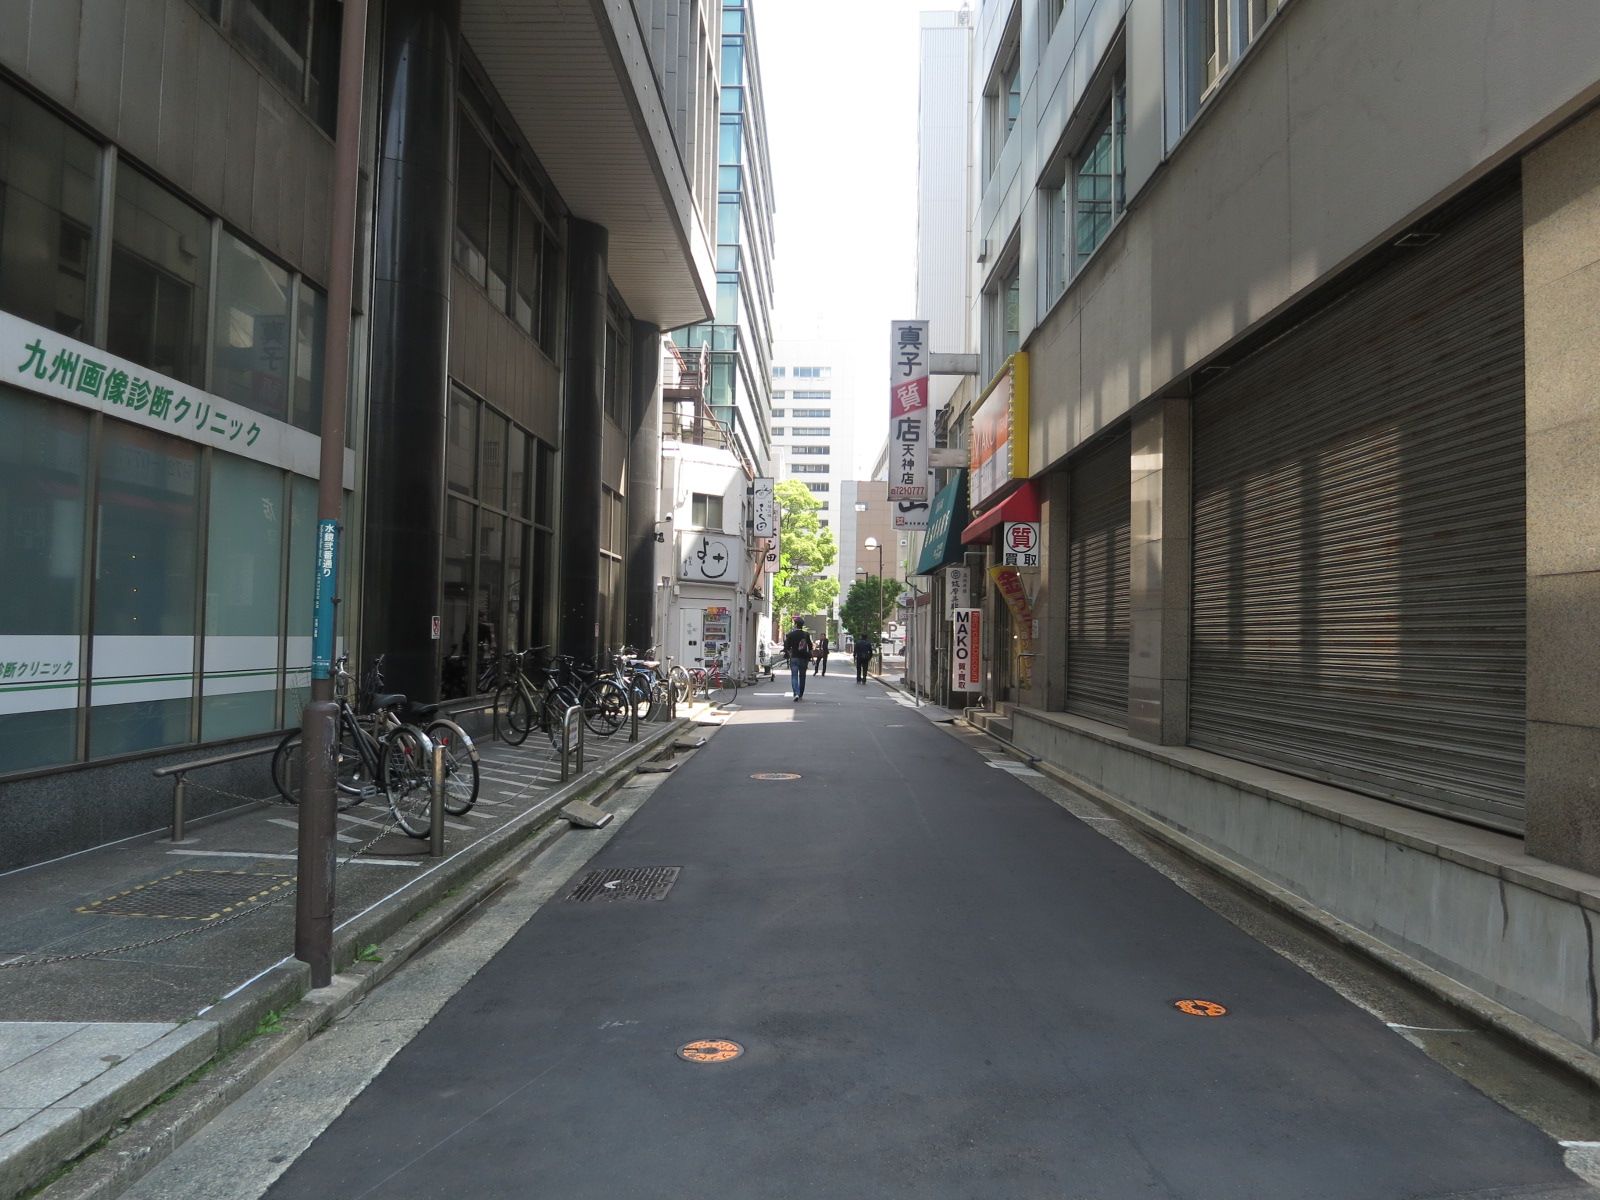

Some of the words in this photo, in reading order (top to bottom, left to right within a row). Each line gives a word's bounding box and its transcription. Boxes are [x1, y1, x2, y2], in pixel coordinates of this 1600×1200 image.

[18, 338, 262, 448] 九州画像診断クリニック
[897, 326, 922, 442] 真子質店
[901, 444, 915, 485] 天神店
[1005, 553, 1037, 566] 買取
[1011, 527, 1032, 549] 質
[957, 612, 969, 660] MAKO
